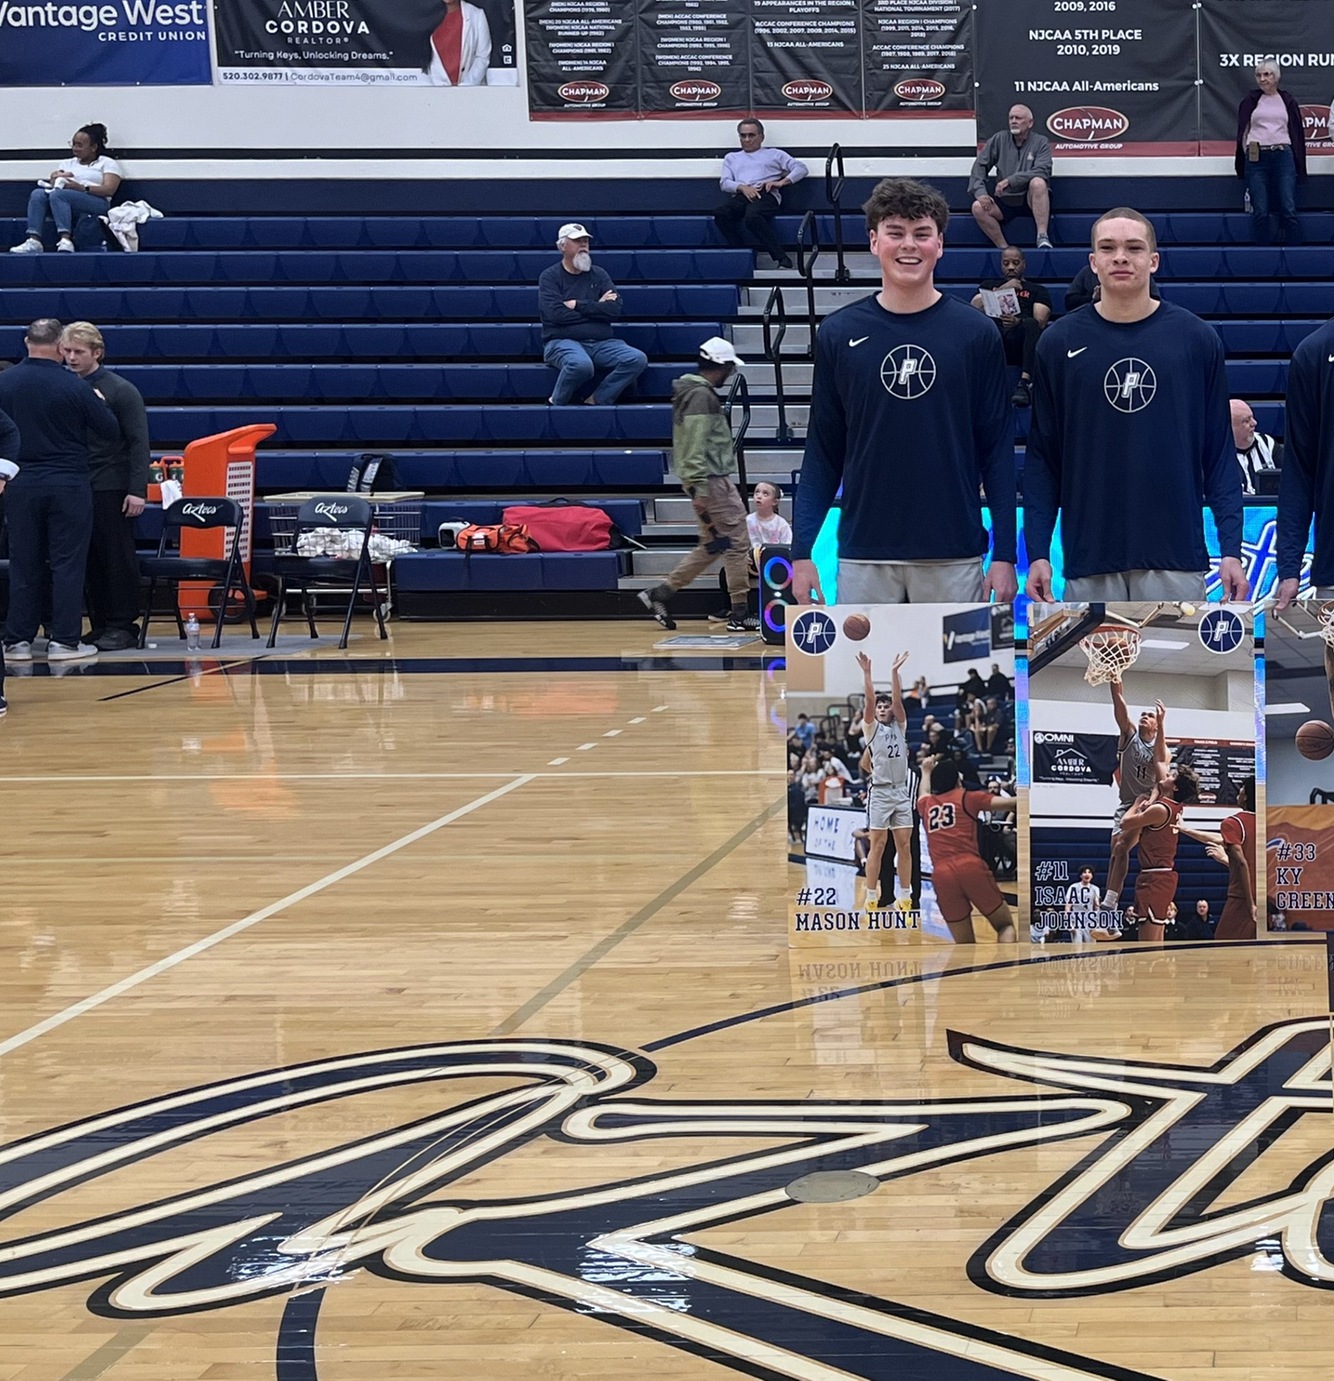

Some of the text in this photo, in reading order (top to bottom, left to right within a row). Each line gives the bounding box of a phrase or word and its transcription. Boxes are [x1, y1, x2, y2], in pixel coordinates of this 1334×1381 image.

[122, 0, 204, 25] West
[277, 1, 350, 18] AMBER
[1054, 1, 1116, 11] 2009, 2016
[98, 31, 206, 41] CREDIT UNION
[265, 21, 370, 34] CORDOVA
[1029, 30, 1142, 41] NJCAA 5TH PLACE
[276, 51, 301, 60] Keys,
[302, 51, 349, 60] Unlocking
[1057, 44, 1121, 56] 2010, 2019
[1219, 54, 1240, 67] 3X
[223, 72, 283, 80] 520.302.9877
[898, 86, 941, 94] CHAPMAN
[1014, 80, 1159, 91] 11 NJCAA All-Americans
[1053, 117, 1123, 130] CHAPMAN
[898, 359, 918, 385] P
[1121, 372, 1141, 398] P
[182, 503, 217, 523] Aztecs
[314, 503, 349, 523] Aztecs
[1045, 734, 1074, 743] OMNI
[1051, 764, 1092, 773] CORDOVA
[928, 802, 955, 833] 23
[1276, 842, 1316, 862] #33
[1035, 861, 1069, 881] #11
[1276, 866, 1303, 886] KY
[796, 888, 836, 906] #22
[1035, 886, 1091, 906] ISAAC
[795, 910, 920, 932] MASON HUNT
[1036, 911, 1124, 930] JOHNSON
